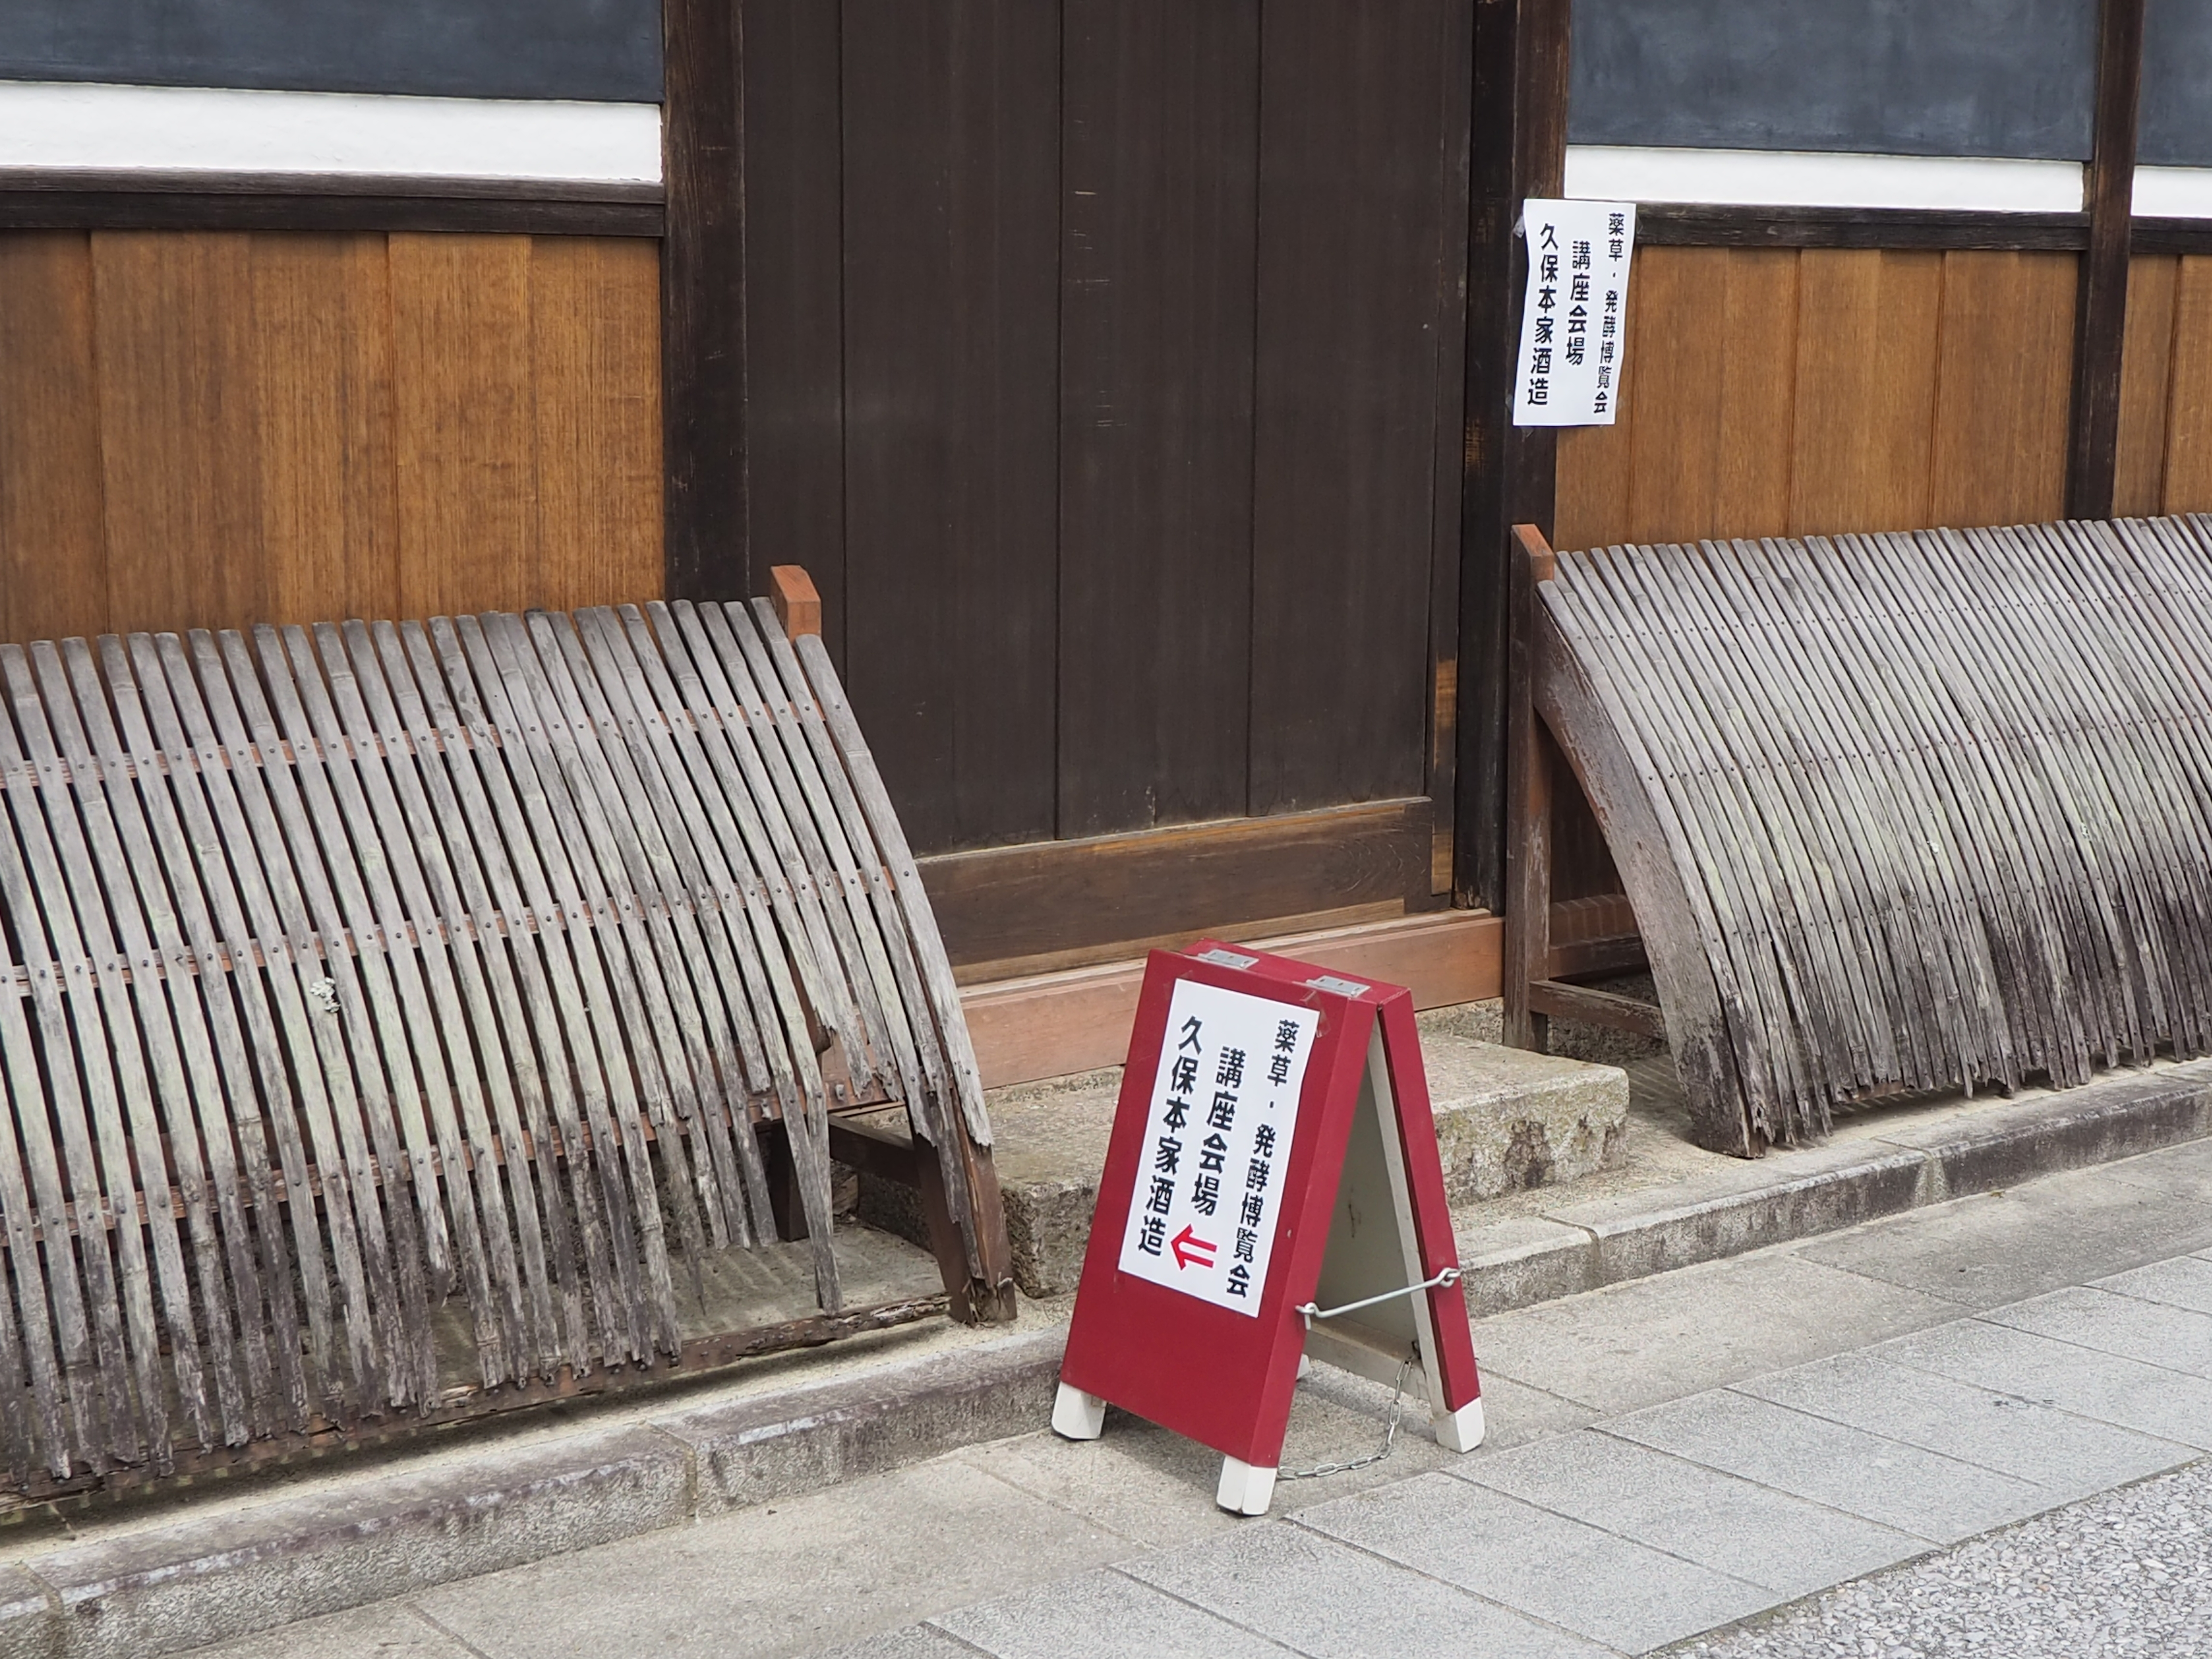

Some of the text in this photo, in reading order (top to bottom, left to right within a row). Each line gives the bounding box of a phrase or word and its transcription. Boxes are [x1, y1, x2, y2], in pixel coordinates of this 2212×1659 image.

[1527, 223, 1559, 405] 久保本家酒造
[1565, 240, 1591, 366] 講座会場
[1594, 213, 1624, 413] 薬草・発酵博覧会
[1138, 1015, 1203, 1256] 久保本家酒造
[1191, 1046, 1247, 1216] 講座会場
[1226, 1019, 1300, 1298] 薬草・発酵博覧会
